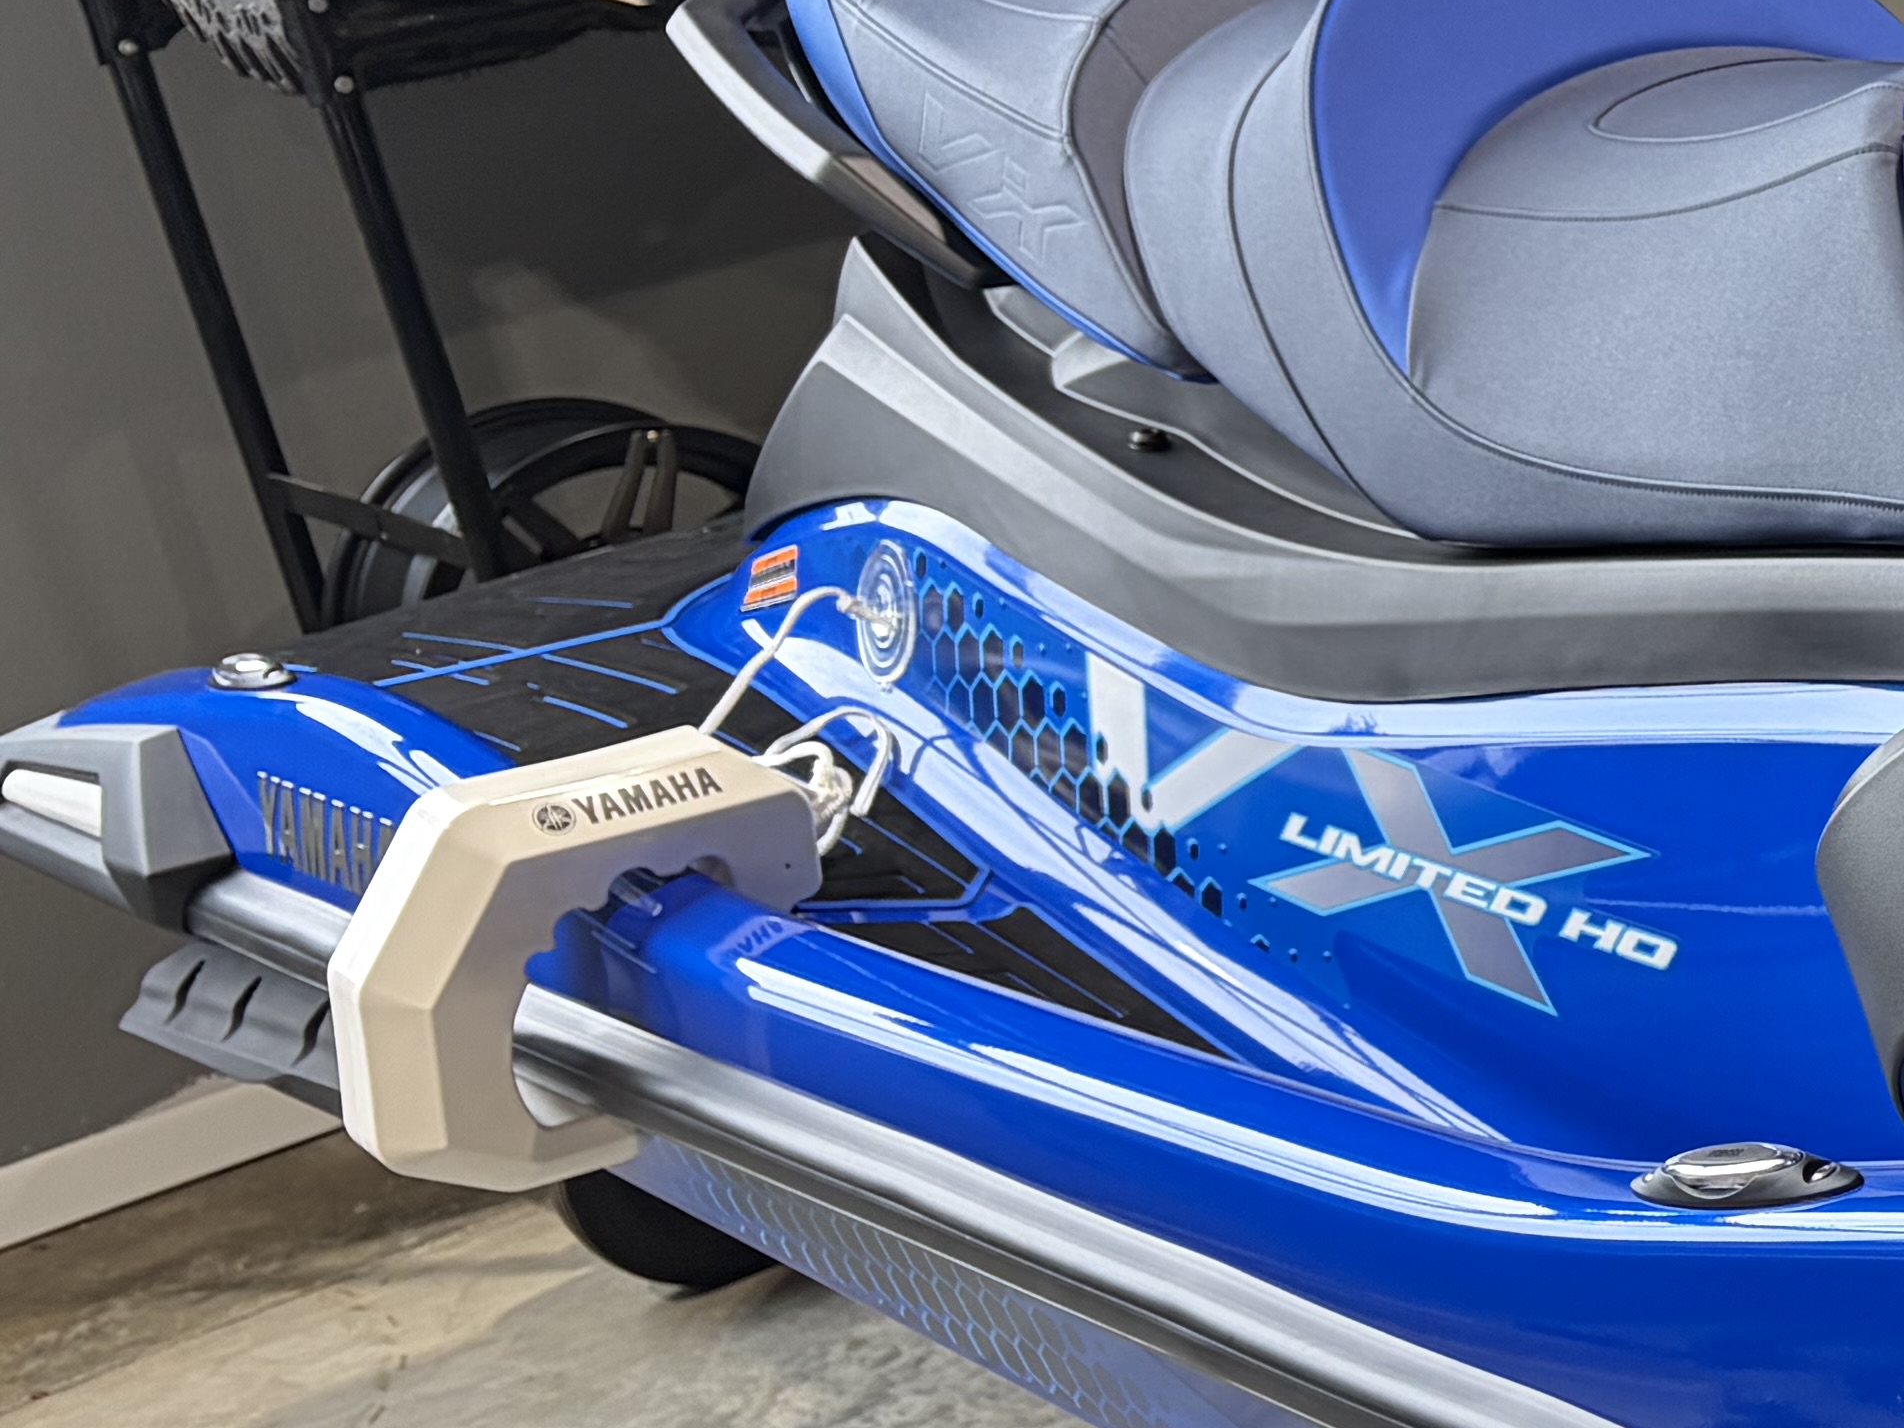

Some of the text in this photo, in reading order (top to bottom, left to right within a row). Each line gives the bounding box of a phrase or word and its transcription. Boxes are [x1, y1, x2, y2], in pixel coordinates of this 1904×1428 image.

[571, 766, 723, 825] YAMAHA
[1280, 810, 1682, 971] LIMITED HO
